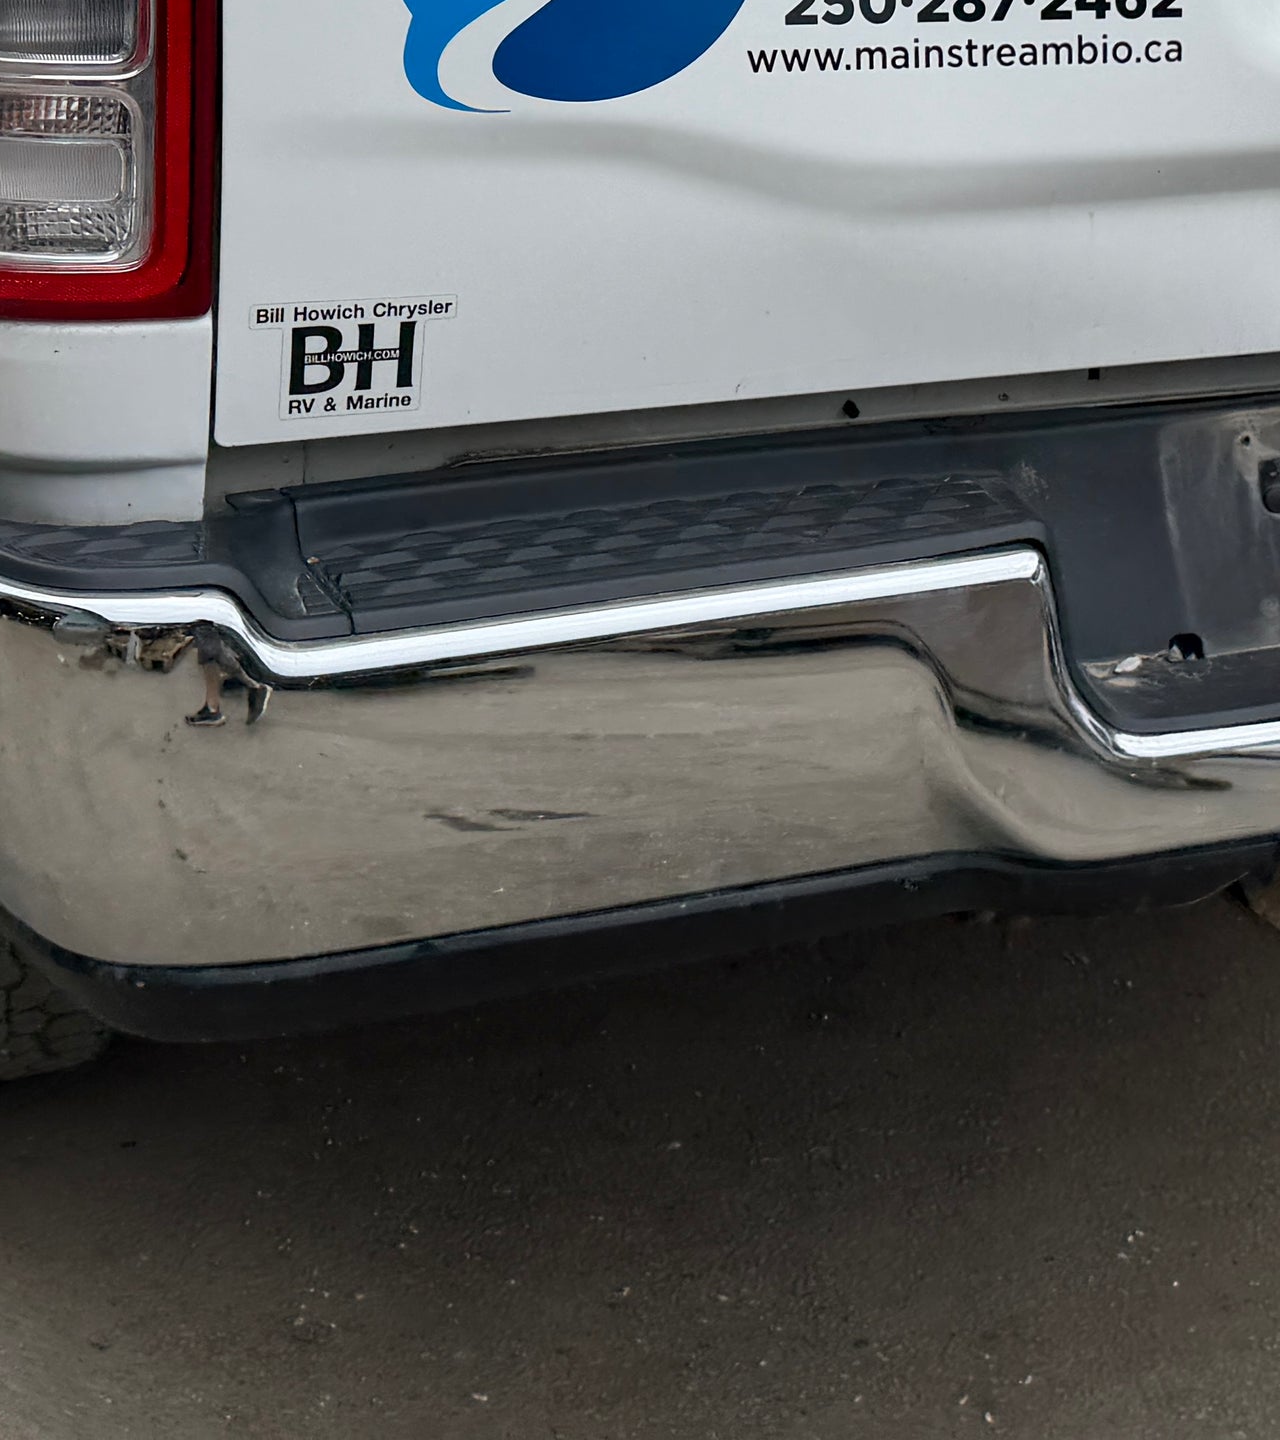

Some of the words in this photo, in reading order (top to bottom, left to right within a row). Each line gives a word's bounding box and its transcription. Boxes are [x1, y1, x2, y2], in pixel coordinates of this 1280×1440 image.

[747, 34, 1183, 73] www.mainstreambio.ca
[256, 307, 285, 324] Bill
[293, 303, 365, 322] Howich
[373, 299, 453, 319] Chrysler
[288, 320, 417, 396] BH
[304, 348, 400, 364] BILLHOWICH.COM
[288, 398, 316, 415] RV
[323, 397, 337, 412] &
[346, 392, 412, 411] Marine
